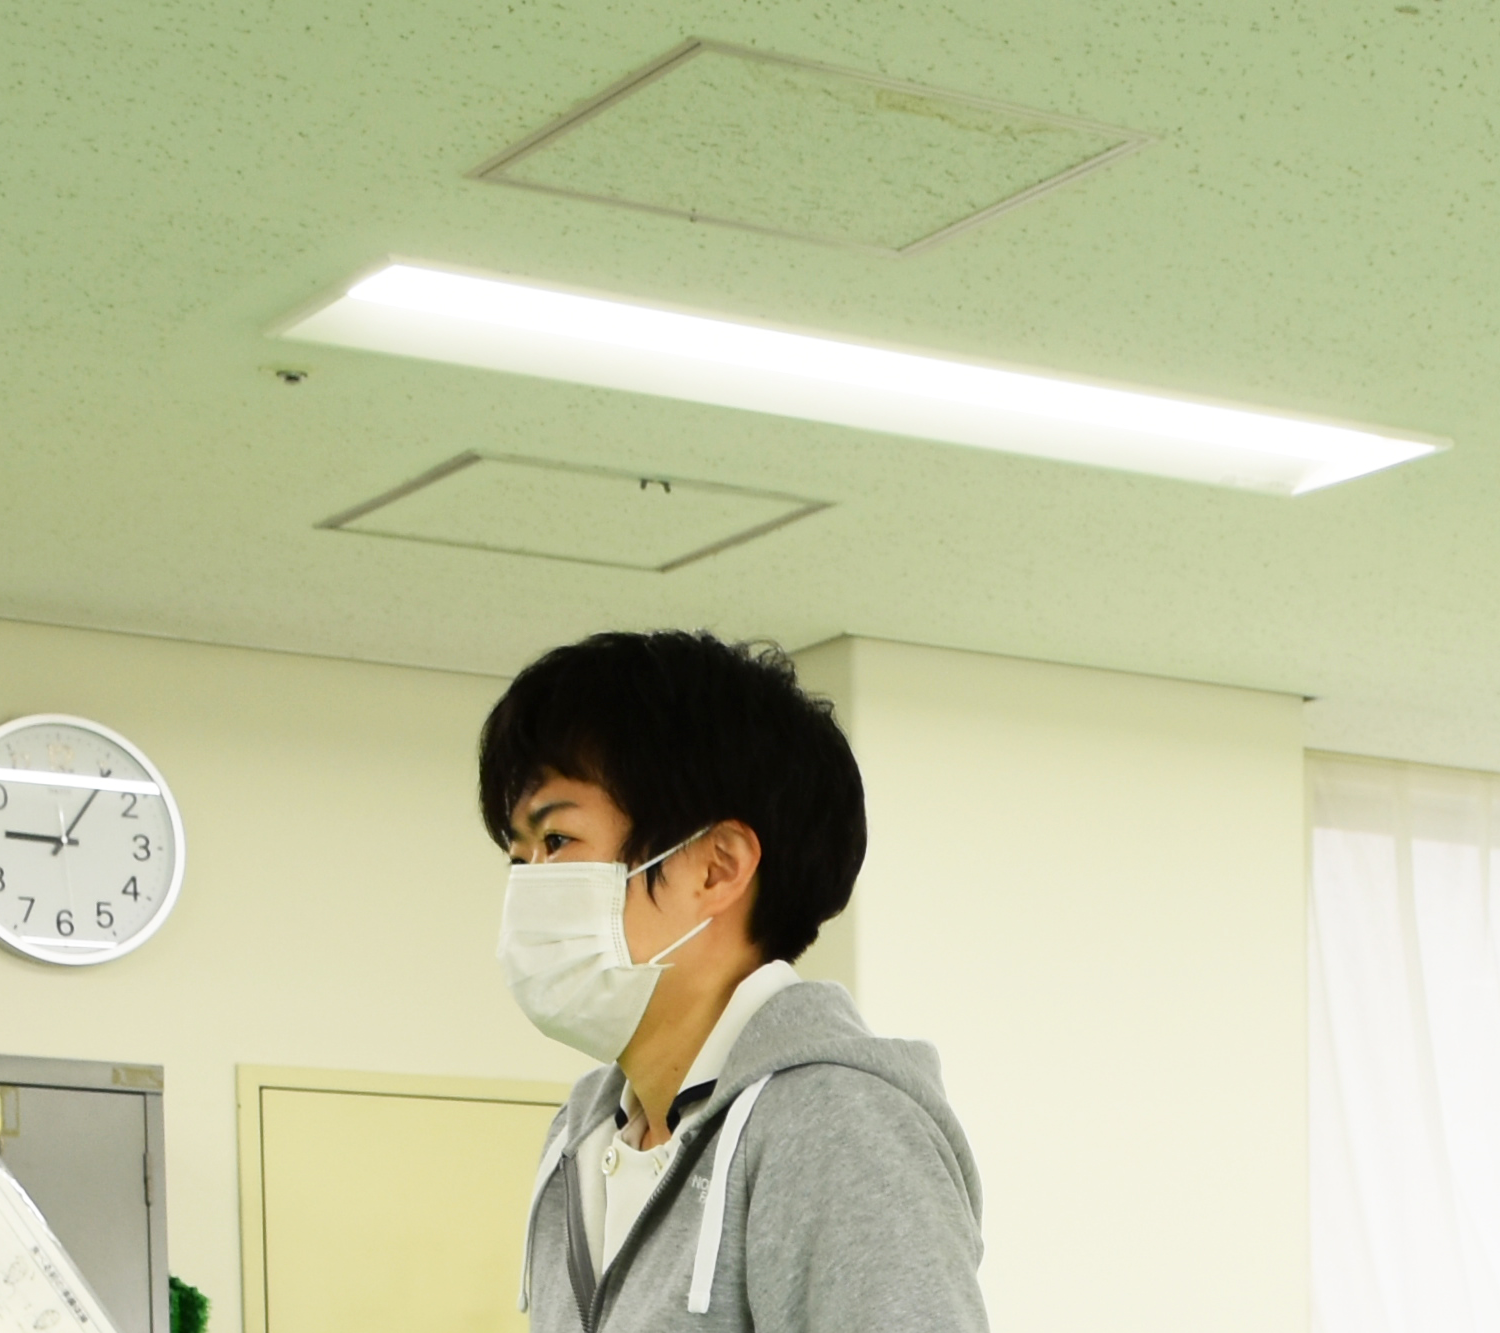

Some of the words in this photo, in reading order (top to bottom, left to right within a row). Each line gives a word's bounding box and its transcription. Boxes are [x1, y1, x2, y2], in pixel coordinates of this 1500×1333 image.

[121, 792, 139, 819] 2
[132, 834, 151, 862] 3
[121, 875, 141, 902] 4
[17, 896, 36, 923] 7
[56, 909, 74, 937] 6
[95, 901, 114, 929] 5
